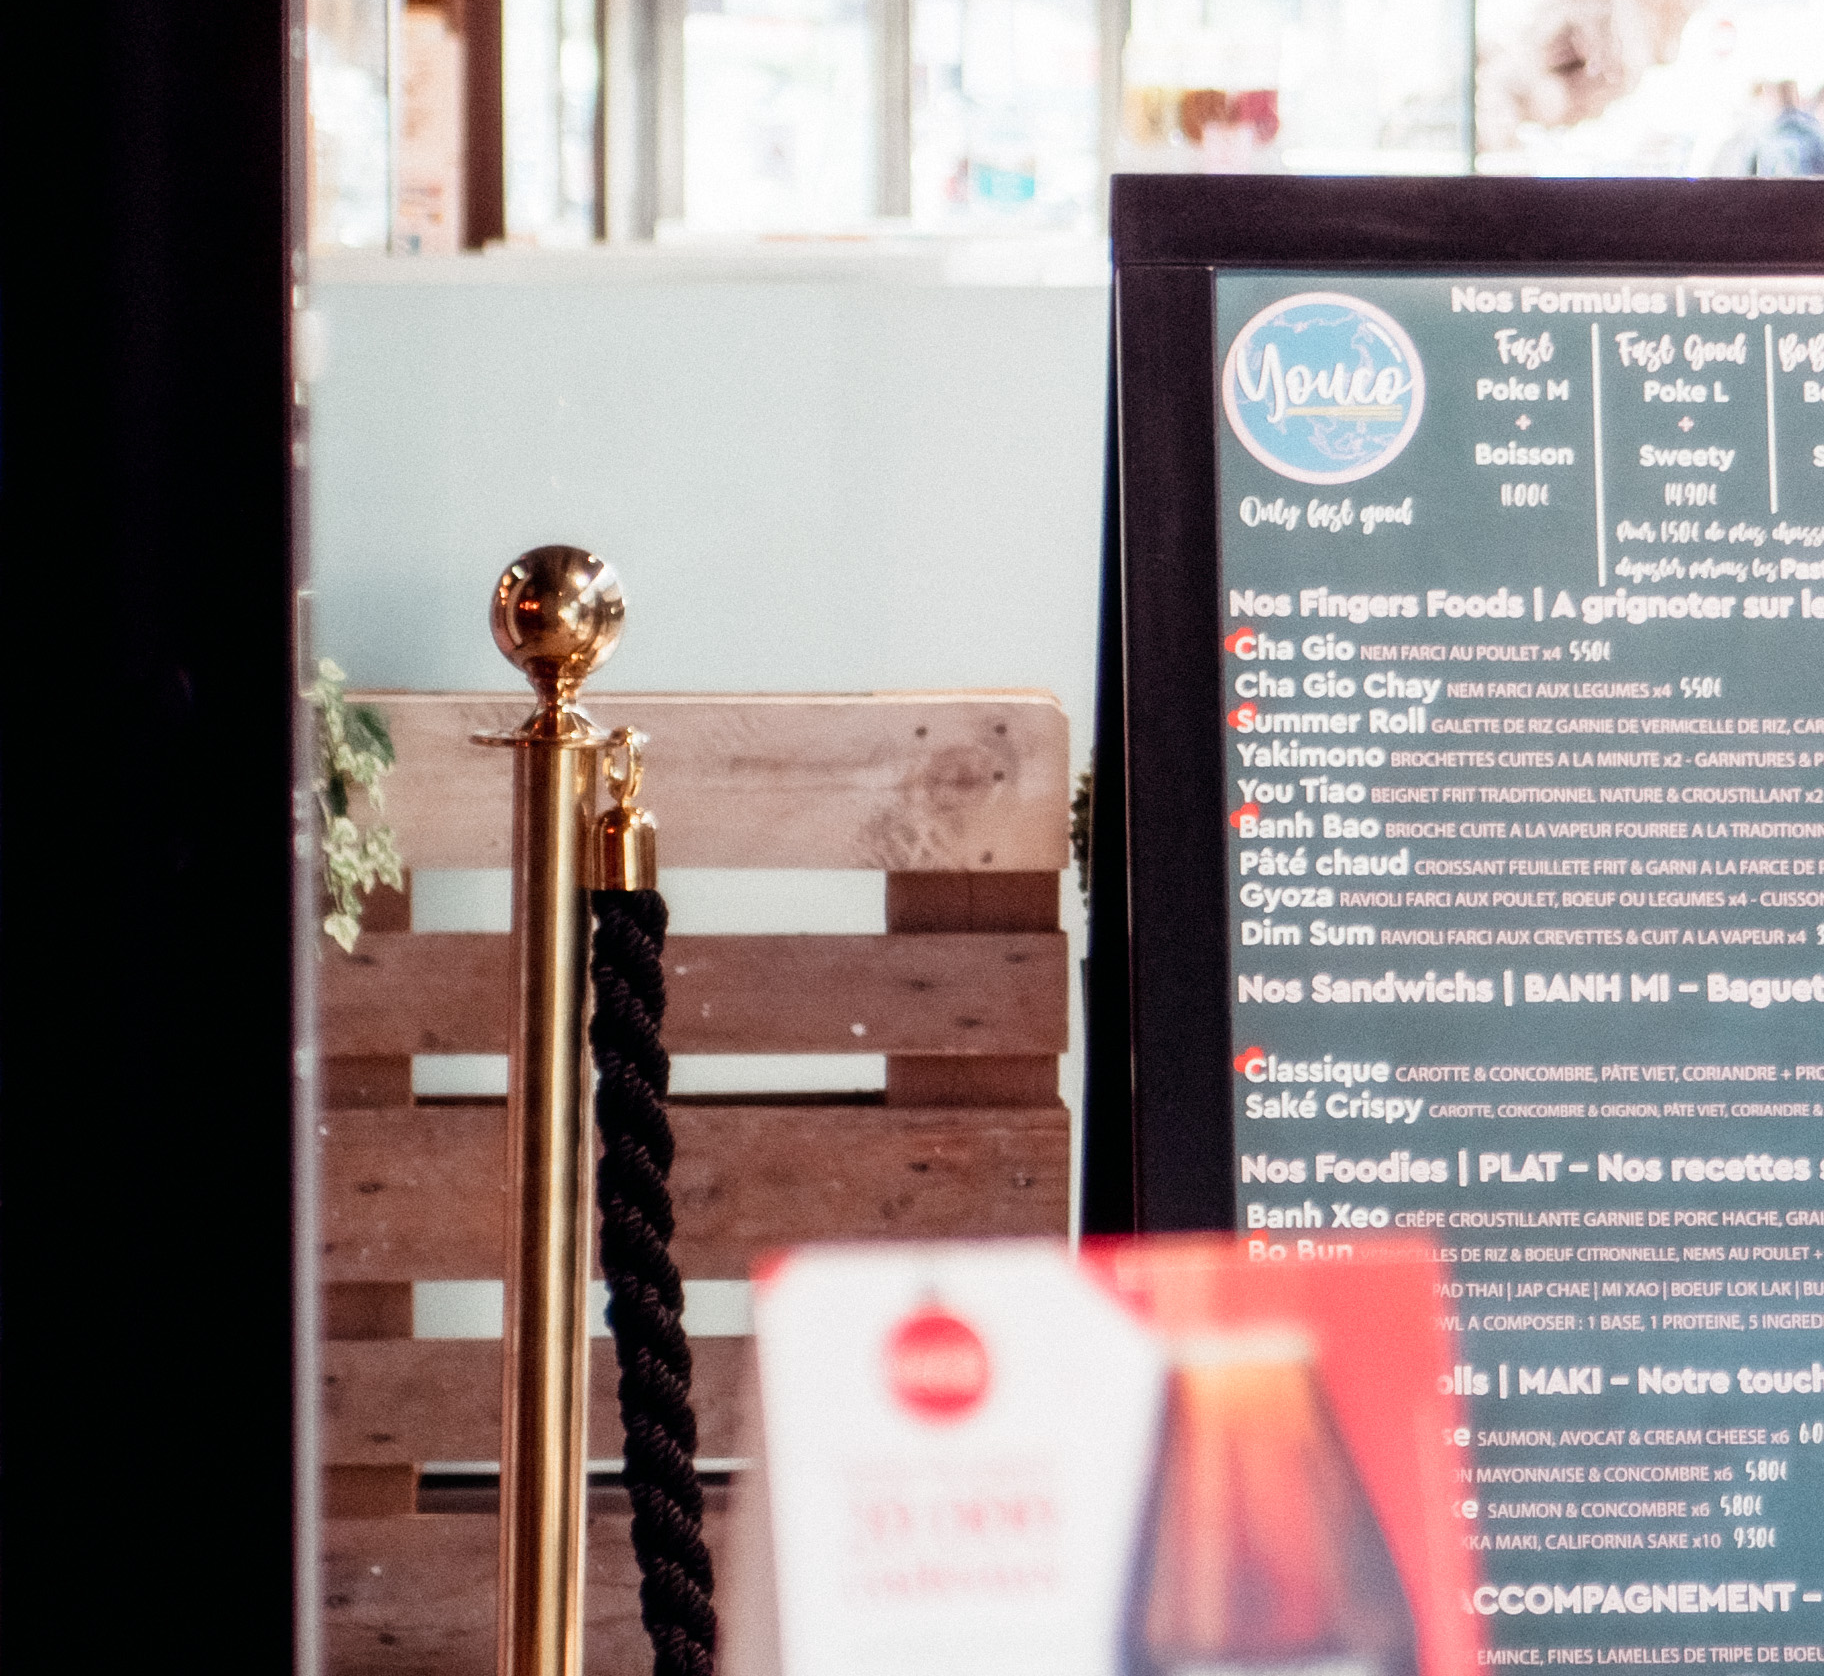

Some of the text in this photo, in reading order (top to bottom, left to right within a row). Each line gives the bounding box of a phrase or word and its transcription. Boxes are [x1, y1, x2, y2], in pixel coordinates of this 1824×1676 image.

[1451, 287, 1513, 313] Nos
[1522, 286, 1667, 314] Formules
[1694, 288, 1824, 319] Toujours
[1477, 377, 1569, 401] Poke M
[1644, 378, 1729, 402] Poke L
[1476, 445, 1574, 465] Boisson
[1640, 444, 1735, 472] Sweety
[1230, 589, 1294, 617] Nos
[1300, 587, 1420, 623] Fingers
[1427, 587, 1525, 618] Foods
[1551, 591, 1577, 618] A
[1581, 587, 1736, 624] grignoter
[1743, 596, 1794, 619] sur
[1234, 633, 1562, 661] Cha Gio NEM FARCI AU POULET x4
[1235, 670, 1672, 704] Cha Gio Chay NEM FARCI AUX LEGUMES x4
[1237, 706, 1426, 734] Summer Roll
[1237, 739, 1660, 767] Yakimono BROCHETTES CUITES A LA MINUTE
[1238, 775, 1366, 803] You Tiao
[1239, 811, 1381, 838] Banh Bao
[1240, 847, 1409, 876] Pâté chaud
[1240, 882, 1335, 913] Gyoza
[1242, 918, 1376, 945] Dim Sum
[1238, 974, 1304, 1003] Nos
[1312, 971, 1495, 1003] Sandwichs
[1525, 973, 1622, 1002] BANH
[1631, 973, 1670, 1002] MI
[1245, 1054, 1391, 1088] Classique
[1246, 1089, 1424, 1124] Saké Crispy
[1242, 1154, 1308, 1183] Nos
[1316, 1150, 1449, 1183] Foodies
[1479, 1152, 1563, 1182] PLAT
[1598, 1153, 1663, 1182] Nos
[1671, 1154, 1812, 1182] recettes
[1248, 1200, 1390, 1229] Banh Xeo
[1465, 1282, 1504, 1297] THAI
[1515, 1282, 1544, 1297] JAP
[1546, 1282, 1590, 1297] CHAE
[1602, 1282, 1622, 1296] MI
[1625, 1282, 1660, 1297] XAO
[1671, 1281, 1723, 1297] BOEUF
[1727, 1281, 1758, 1297] LOK
[1761, 1281, 1791, 1296] LAK
[1437, 1365, 1489, 1395] olls
[1519, 1366, 1602, 1394] MAKI
[1638, 1366, 1731, 1394] Notre
[1477, 1430, 1556, 1447] SAUMON,
[1559, 1429, 1625, 1445] AVOCAT
[1643, 1429, 1702, 1445] CREAM
[1705, 1428, 1767, 1445] CHEESE
[1771, 1429, 1790, 1444] x6
[1488, 1502, 1563, 1518] SAUMON
[1581, 1501, 1687, 1518] CONCOMBRE
[1691, 1502, 1711, 1517] x6
[1496, 1532, 1722, 1551] MAKI, CALIFORNIA SAKE x10
